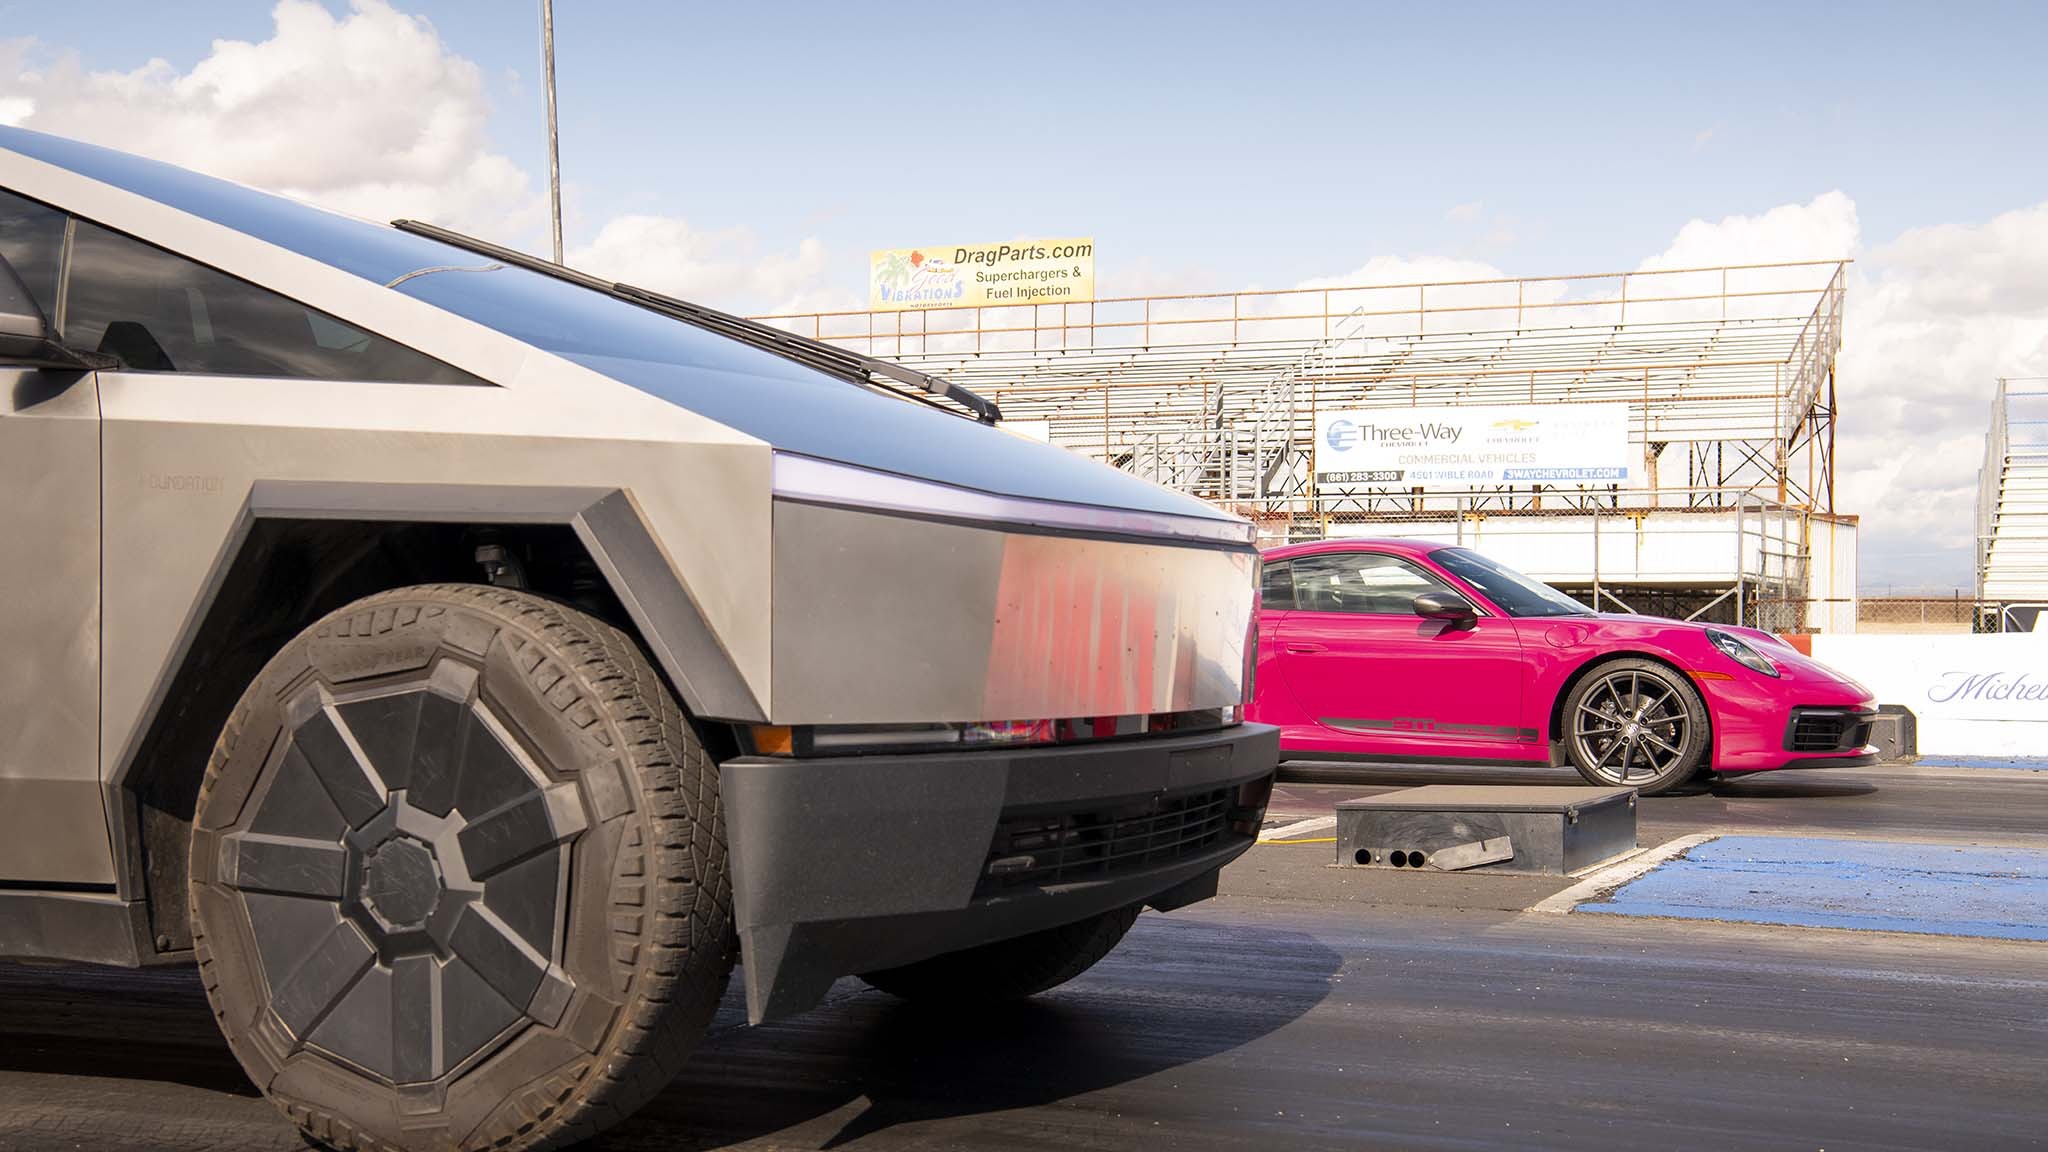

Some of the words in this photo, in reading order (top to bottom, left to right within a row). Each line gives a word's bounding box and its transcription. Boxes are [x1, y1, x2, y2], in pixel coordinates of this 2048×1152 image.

[954, 244, 1093, 267] DragParts.com
[976, 268, 1069, 284] Superchargers
[1072, 266, 1082, 278] &
[986, 288, 1014, 299] Fuel
[1017, 284, 1071, 300] Injection
[1358, 423, 1463, 444] Three-Way
[1398, 454, 1475, 465] COMMERCIAL
[1478, 452, 1537, 464] VEHICLES
[1350, 471, 1397, 482] 283-3300
[1507, 468, 1620, 479] 3WAYCHEVROLET.COM
